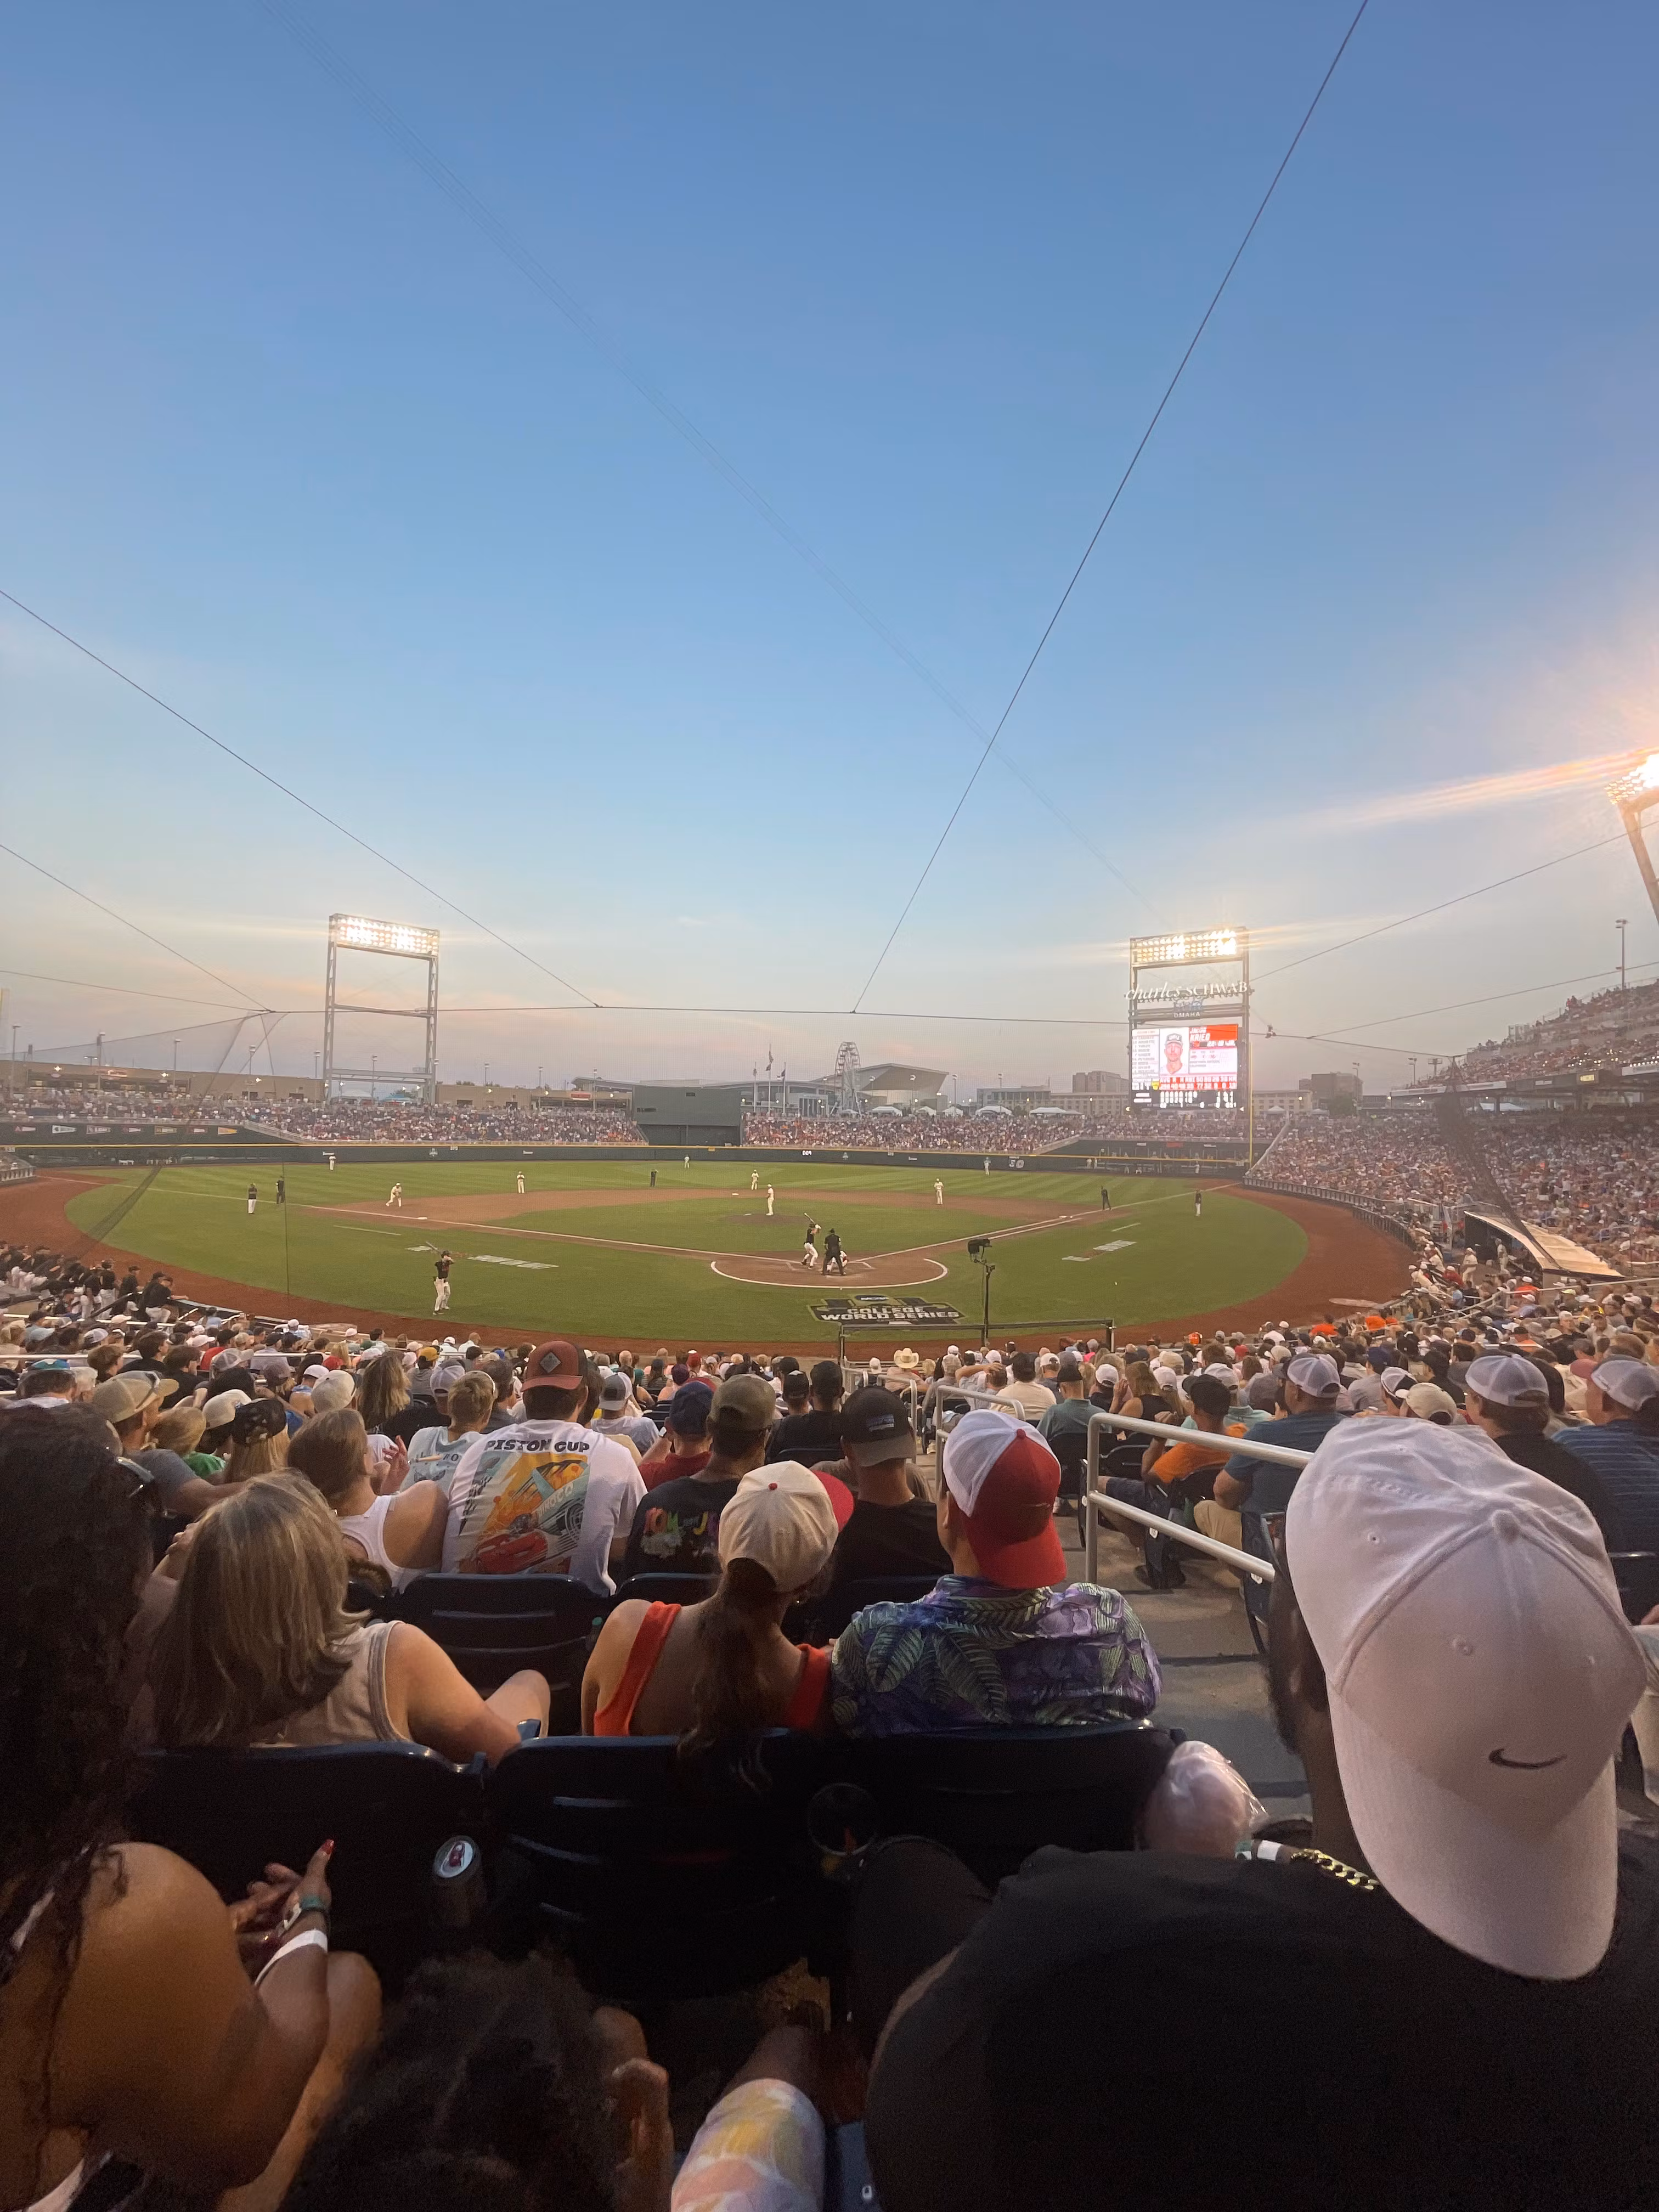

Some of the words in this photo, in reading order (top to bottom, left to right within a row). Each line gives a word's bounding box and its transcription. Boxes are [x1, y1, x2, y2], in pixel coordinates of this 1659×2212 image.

[1126, 981, 1182, 1000] charles
[1186, 981, 1248, 997] SCHWAB
[484, 1439, 552, 1452] PISTON
[554, 1441, 590, 1453] CUP
